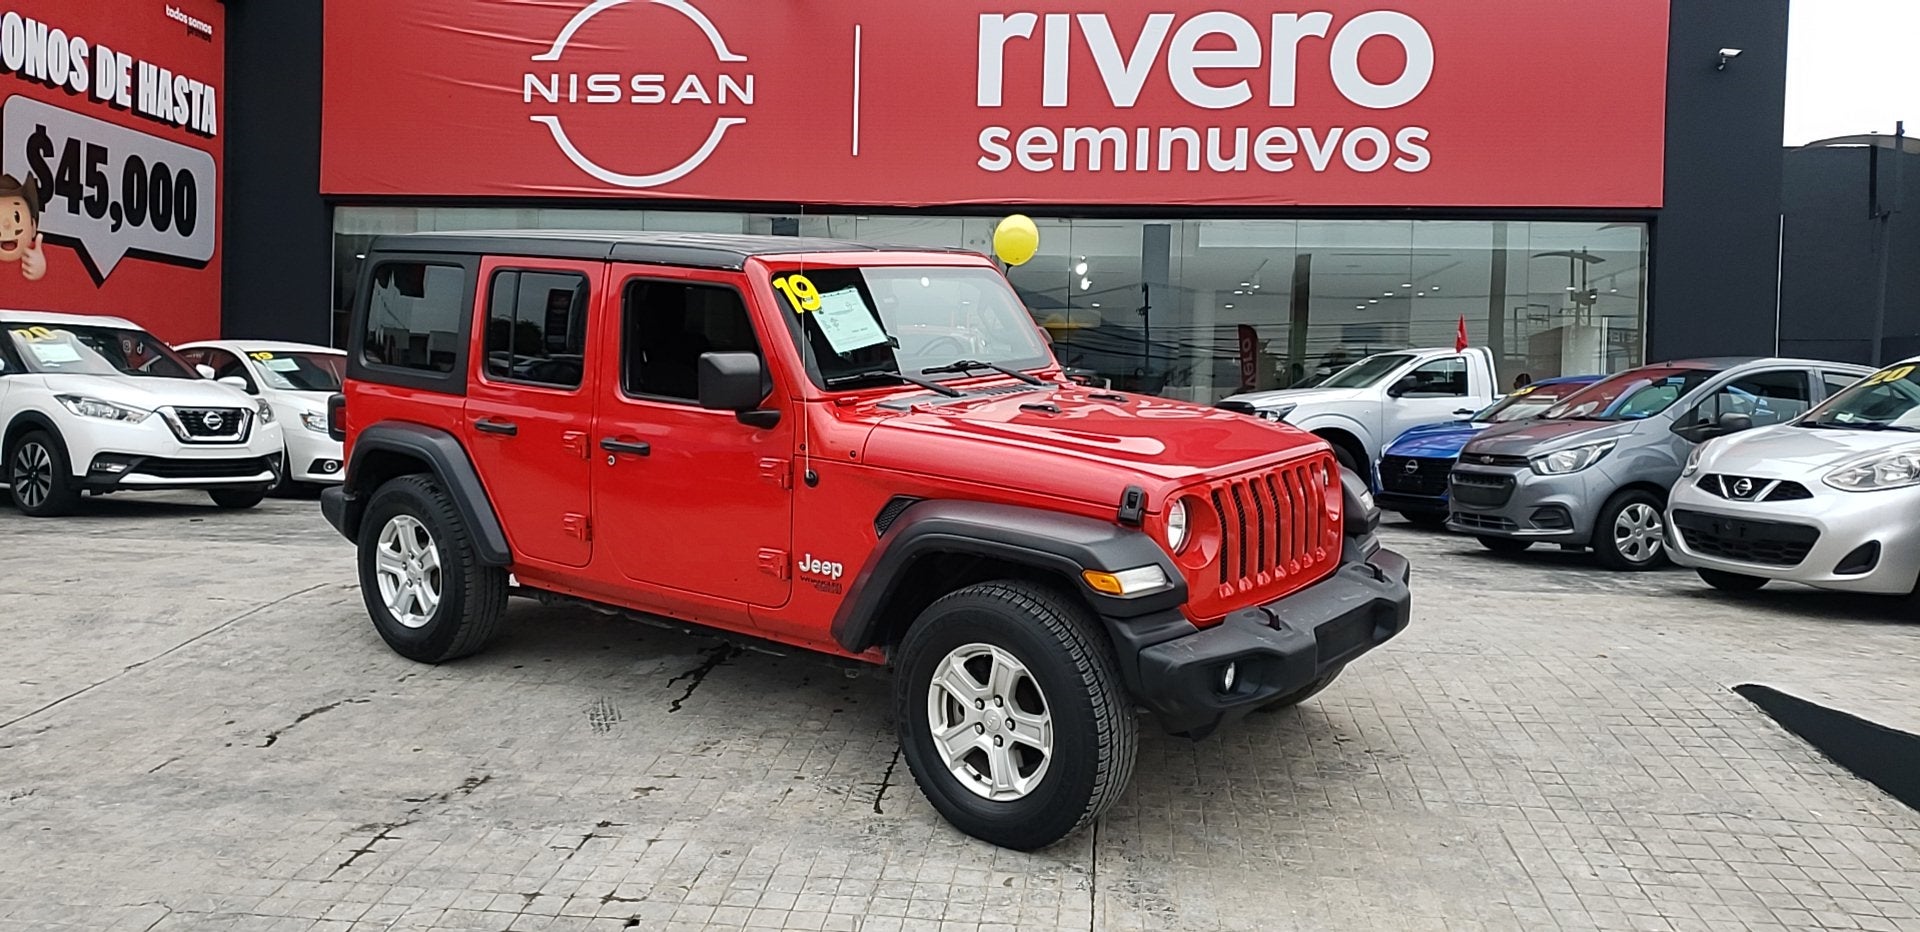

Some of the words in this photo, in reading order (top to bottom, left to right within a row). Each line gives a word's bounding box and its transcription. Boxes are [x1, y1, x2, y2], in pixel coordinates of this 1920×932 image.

[166, 4, 188, 24] todos
[188, 16, 212, 35] somos
[0, 11, 89, 93] ONOS
[96, 44, 132, 109] DE
[138, 59, 217, 135] HASTA
[977, 10, 1435, 109] rivero
[524, 73, 754, 105] NISSAN
[977, 126, 1431, 172] seminuevos
[26, 124, 197, 237] $45,000
[772, 274, 821, 314] 19
[1859, 365, 1916, 388] 20
[798, 553, 843, 580] Jeep
